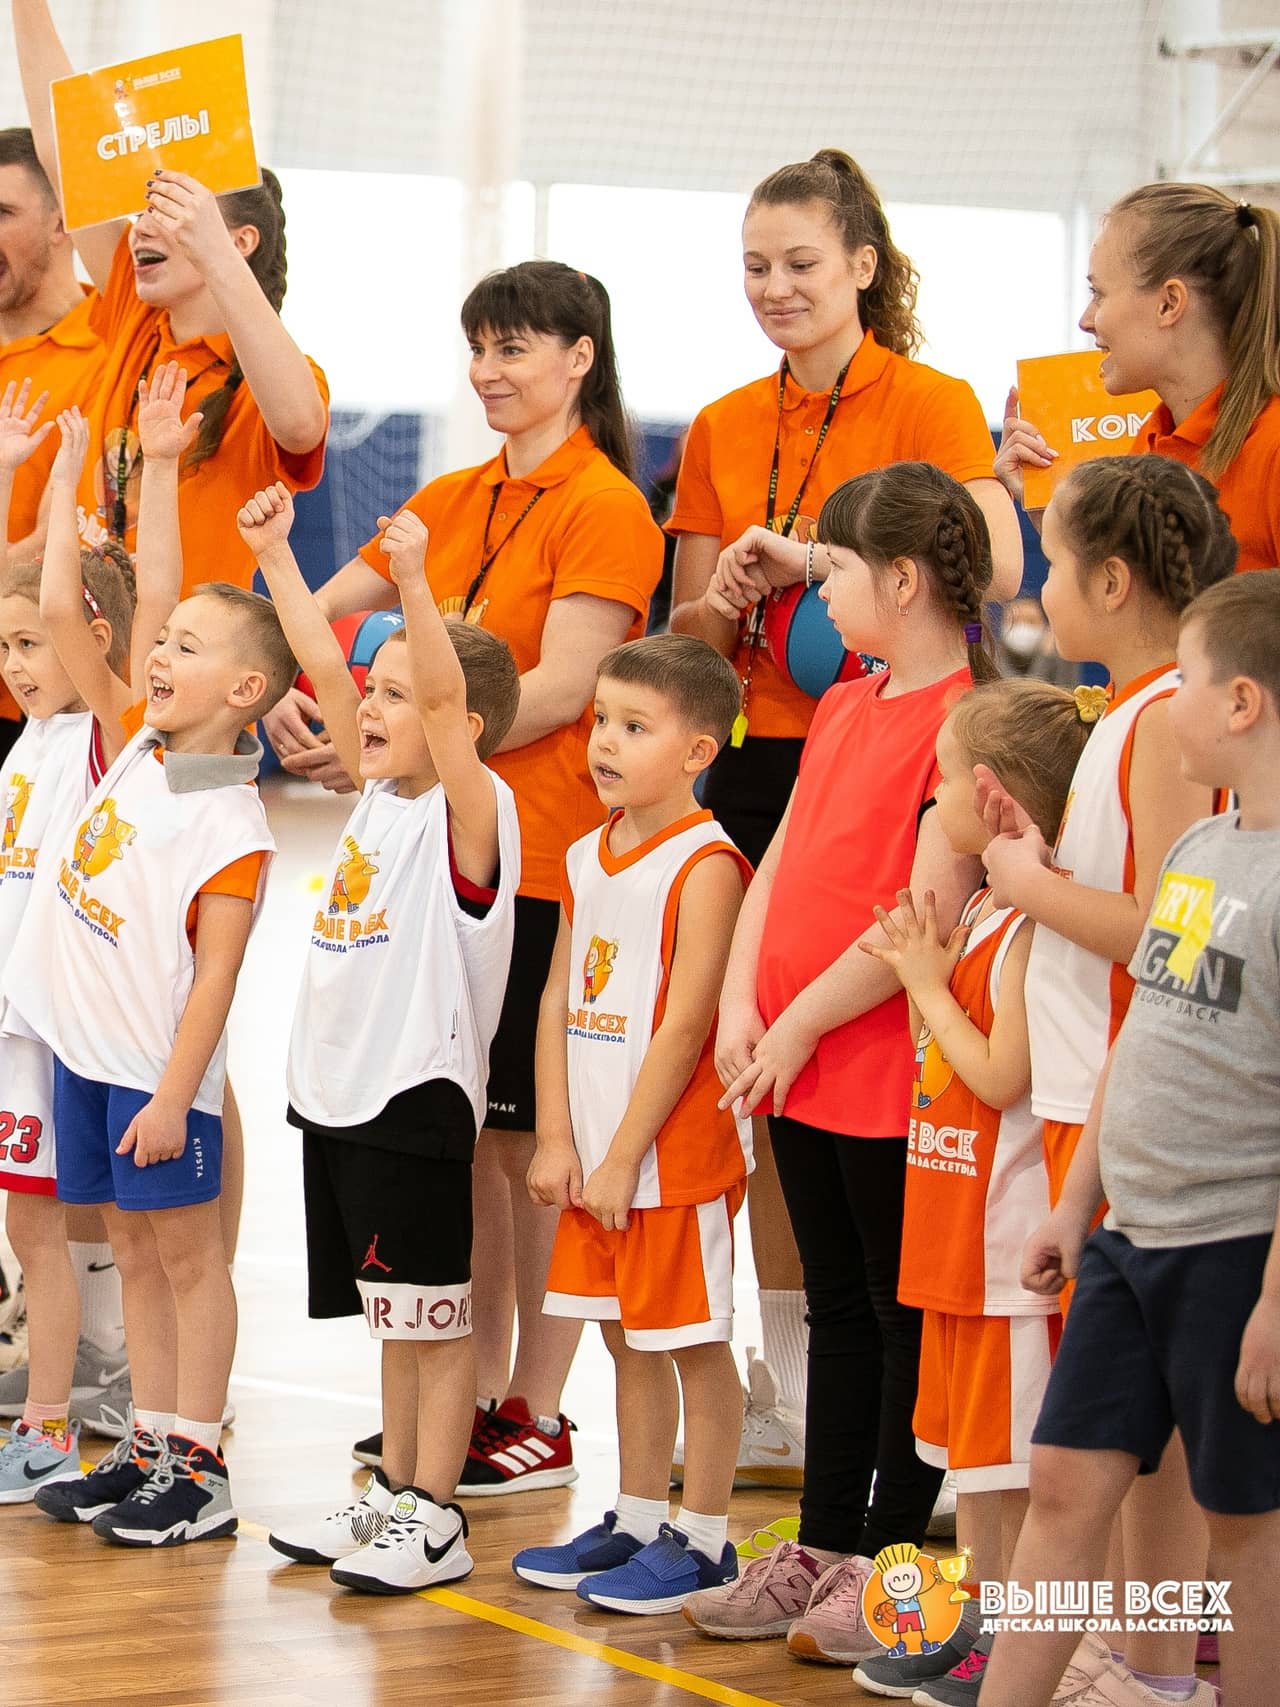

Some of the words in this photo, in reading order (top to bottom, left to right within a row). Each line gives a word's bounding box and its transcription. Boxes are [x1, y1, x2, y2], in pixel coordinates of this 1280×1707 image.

[96, 109, 210, 161] СТРЕЛЫ
[1212, 895, 1249, 938] IT
[192, 1137, 204, 1179] KIPSTA
[404, 1297, 471, 1330] JOR
